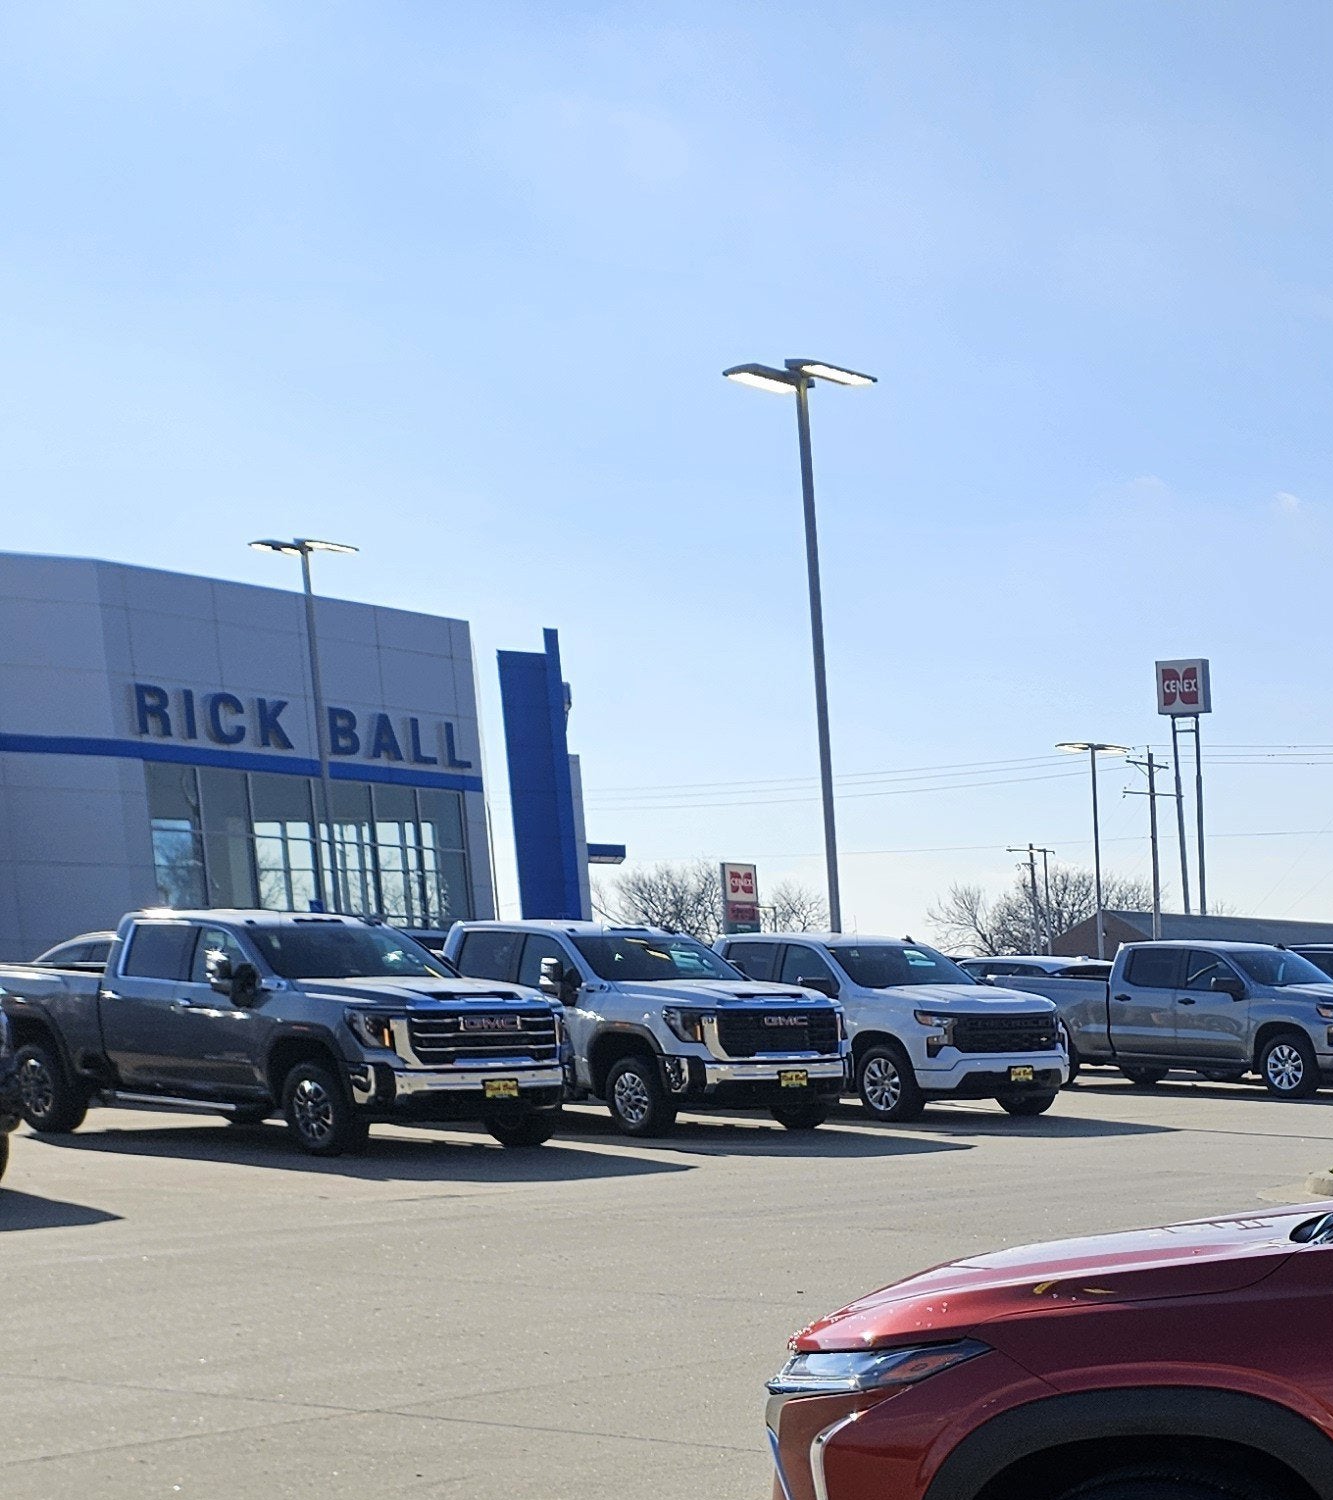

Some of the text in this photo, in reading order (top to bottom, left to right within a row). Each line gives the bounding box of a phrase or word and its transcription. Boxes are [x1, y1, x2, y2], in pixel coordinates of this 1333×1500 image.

[1164, 679, 1197, 693] CENEX
[132, 683, 473, 769] RICK BALL
[464, 1017, 517, 1030] GMC
[764, 1016, 808, 1026] GMC
